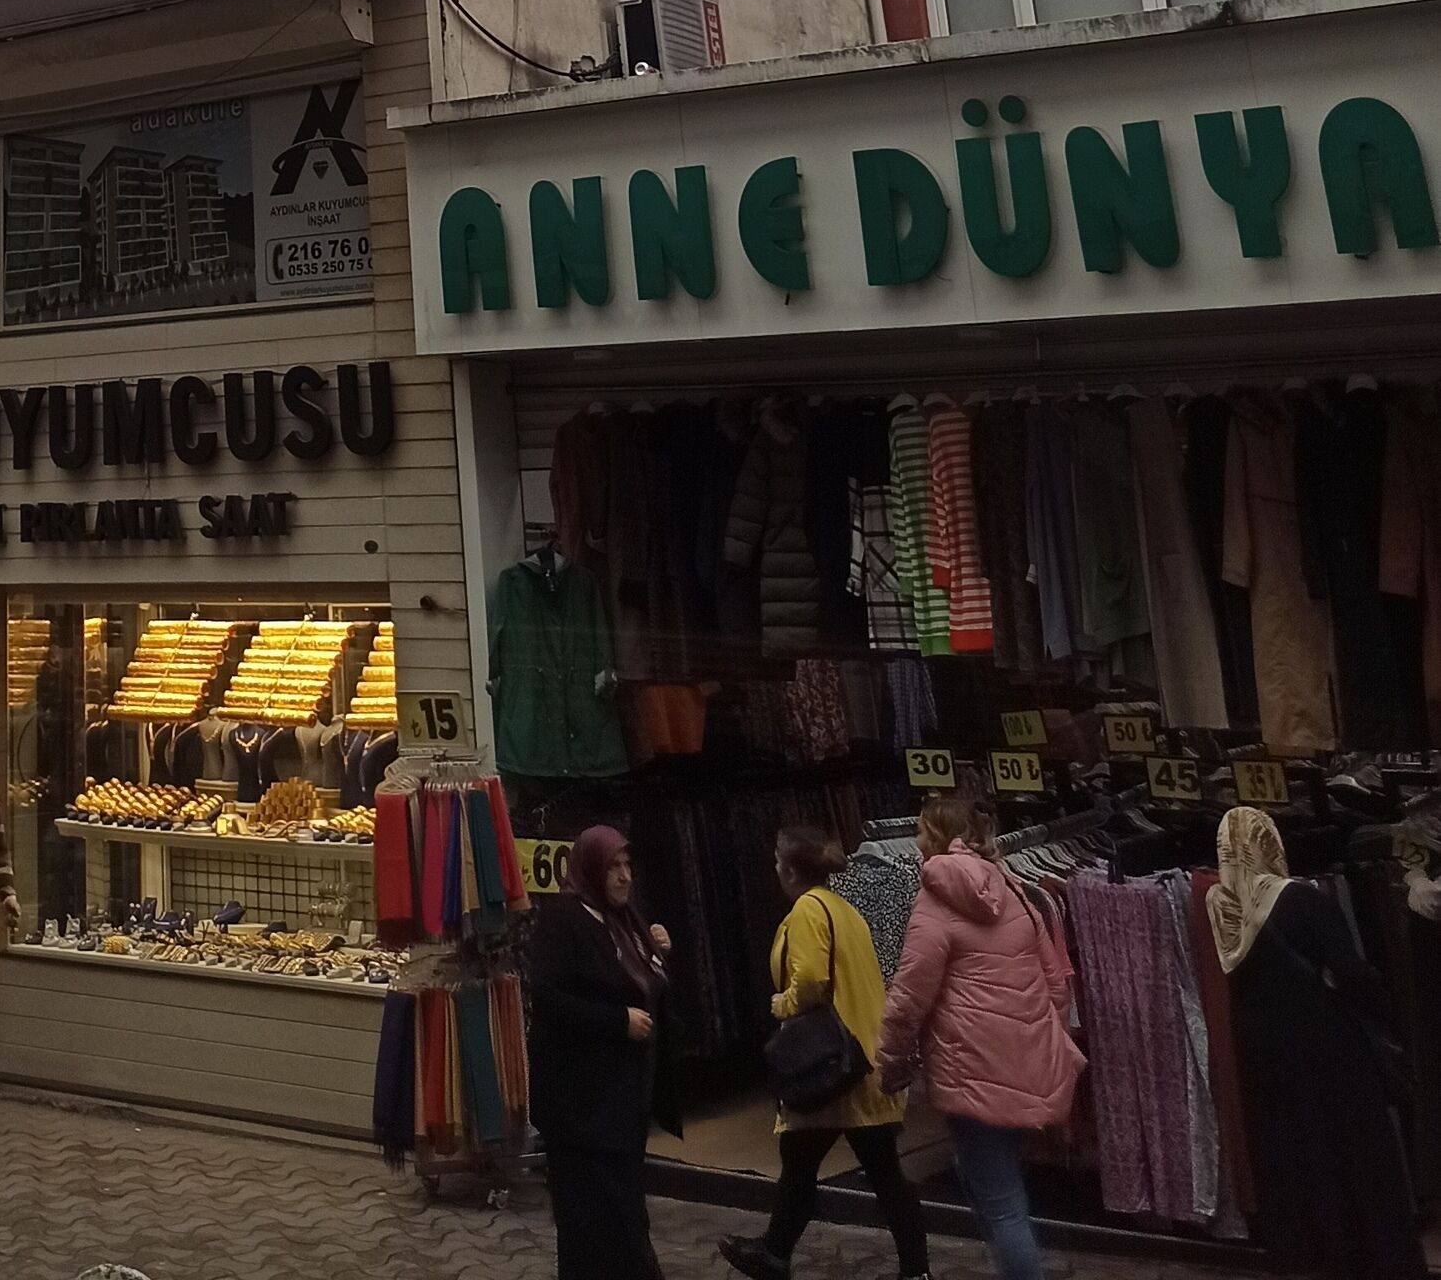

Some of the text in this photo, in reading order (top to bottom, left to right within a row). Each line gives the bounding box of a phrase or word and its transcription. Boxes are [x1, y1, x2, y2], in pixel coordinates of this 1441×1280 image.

[270, 198, 316, 217] AYDINLAR
[439, 94, 1441, 314] ANNE DÜNYA
[288, 242, 322, 263] 216
[327, 238, 352, 258] 76
[288, 263, 318, 277] 0535
[321, 260, 345, 274] 250
[348, 258, 364, 271] 75
[198, 492, 297, 539] SAAT
[1114, 721, 1137, 742] 50
[912, 754, 951, 776] 30
[998, 759, 1021, 781] 50
[1155, 761, 1198, 792] 45
